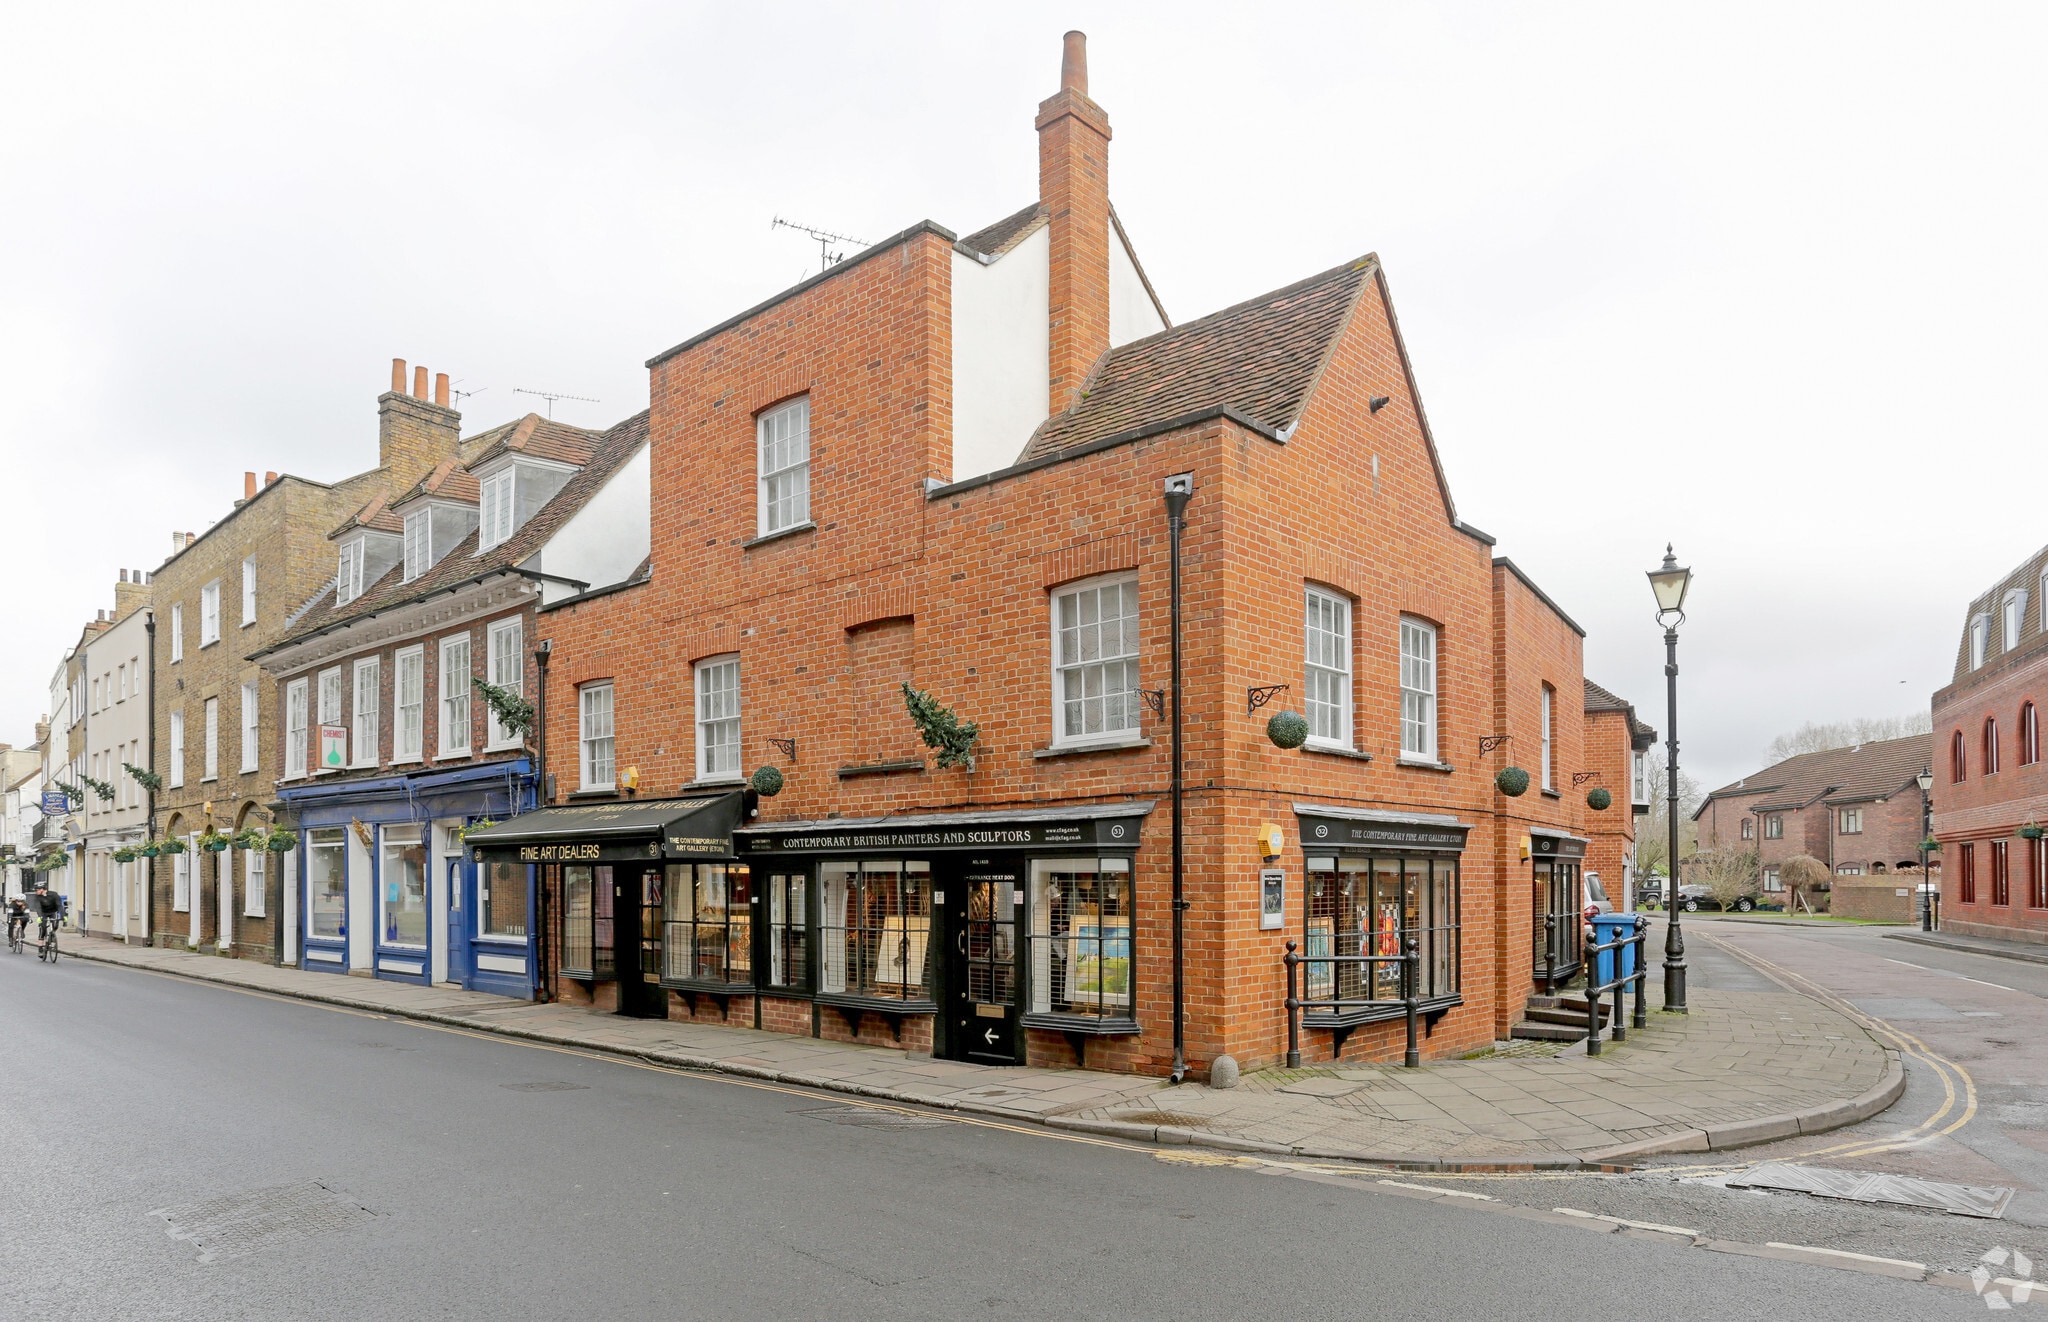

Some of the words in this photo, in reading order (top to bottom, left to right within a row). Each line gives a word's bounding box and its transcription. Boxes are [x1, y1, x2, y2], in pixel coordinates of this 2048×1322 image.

[323, 730, 345, 739] CHEMIST
[652, 802, 674, 811] ART
[783, 836, 851, 848] CONTEMPORARY
[853, 834, 890, 846] BRITISH
[891, 833, 941, 845] PAINTERS
[943, 832, 965, 843] AND
[967, 830, 1031, 843] SCULPTORS
[1351, 829, 1362, 839] THE
[1363, 830, 1405, 841] CONTEMPORARY
[1405, 833, 1417, 842] FINE
[1418, 834, 1428, 842] ART
[1428, 834, 1449, 843] GALLERY
[521, 847, 539, 860] FINE
[541, 846, 557, 859] ART
[559, 845, 600, 859] DEALERS
